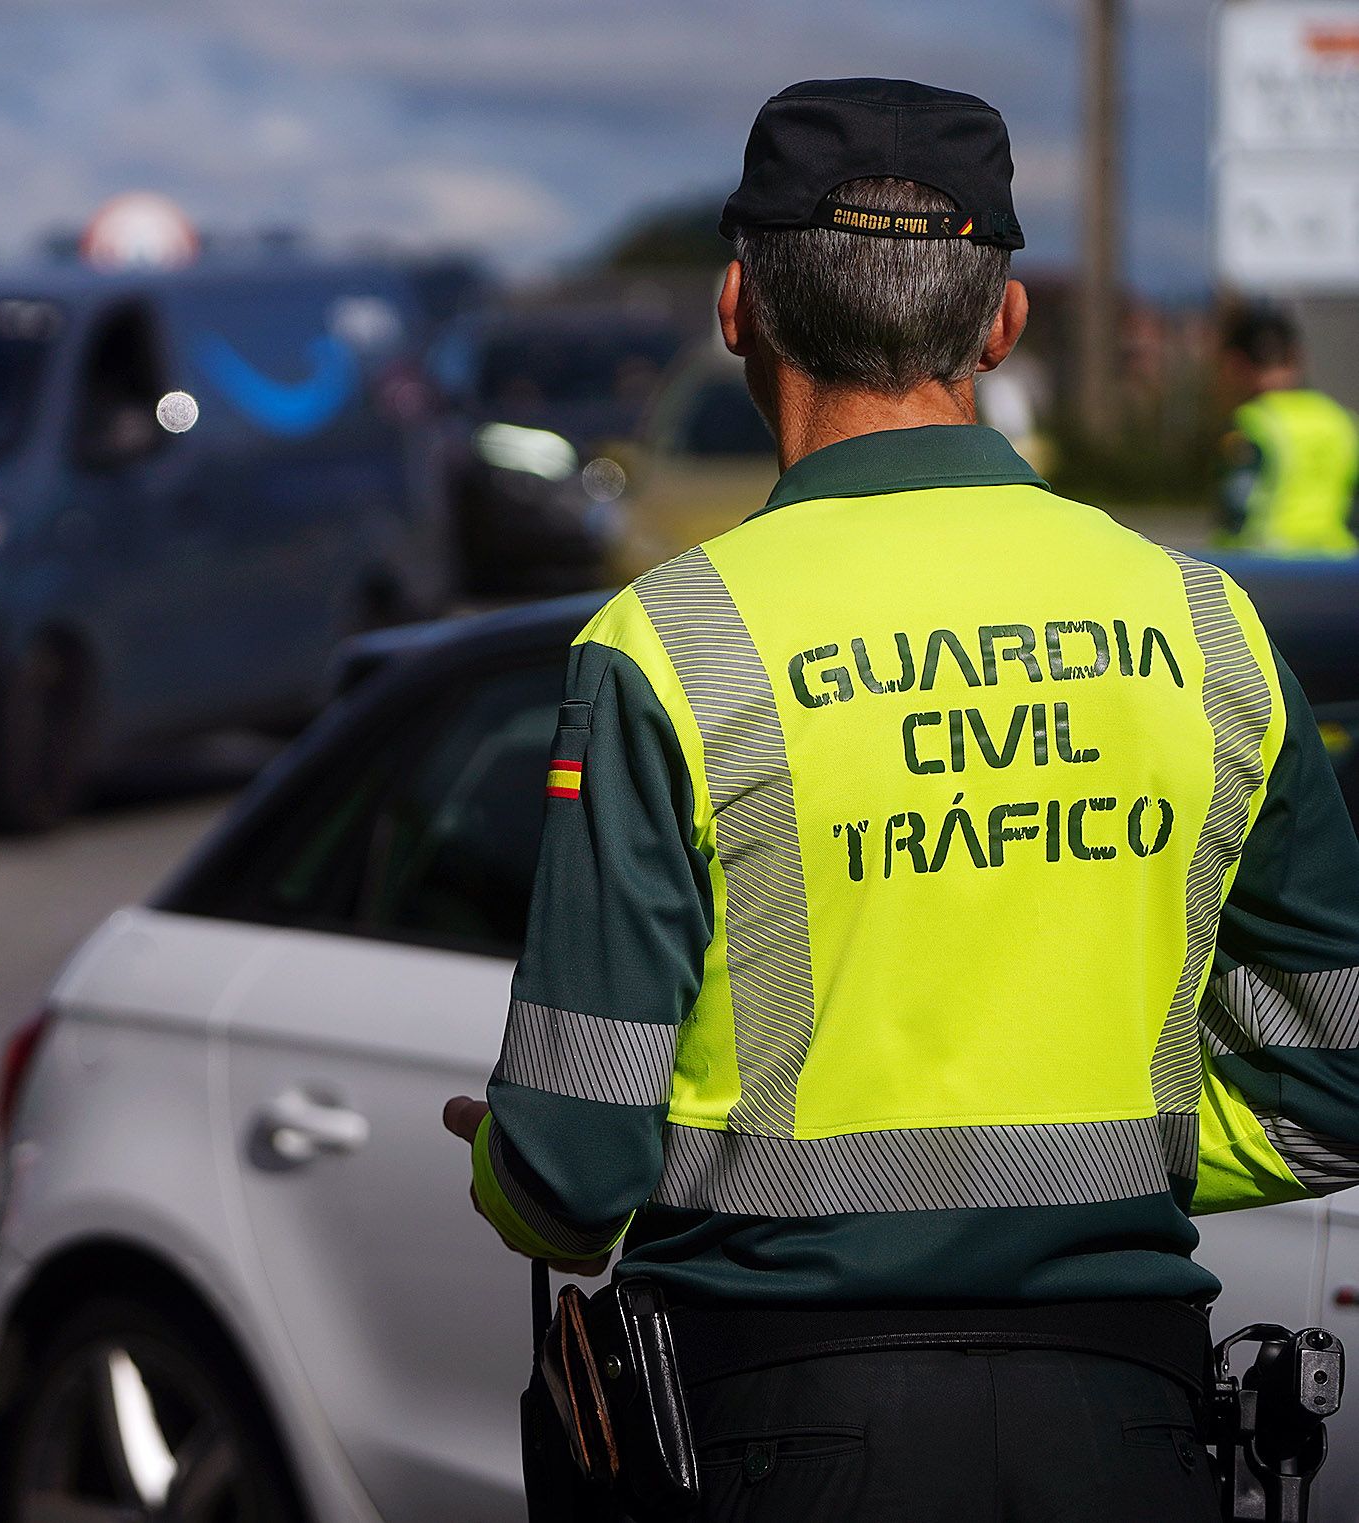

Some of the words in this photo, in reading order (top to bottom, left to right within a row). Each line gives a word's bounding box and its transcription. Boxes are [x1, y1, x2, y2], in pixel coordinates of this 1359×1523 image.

[833, 208, 890, 230] GUARDIA
[894, 217, 928, 233] CIVIL
[788, 620, 1183, 708] GUARDIA
[902, 702, 1100, 774] CIVIL
[833, 792, 1174, 881] TRÁFICO
